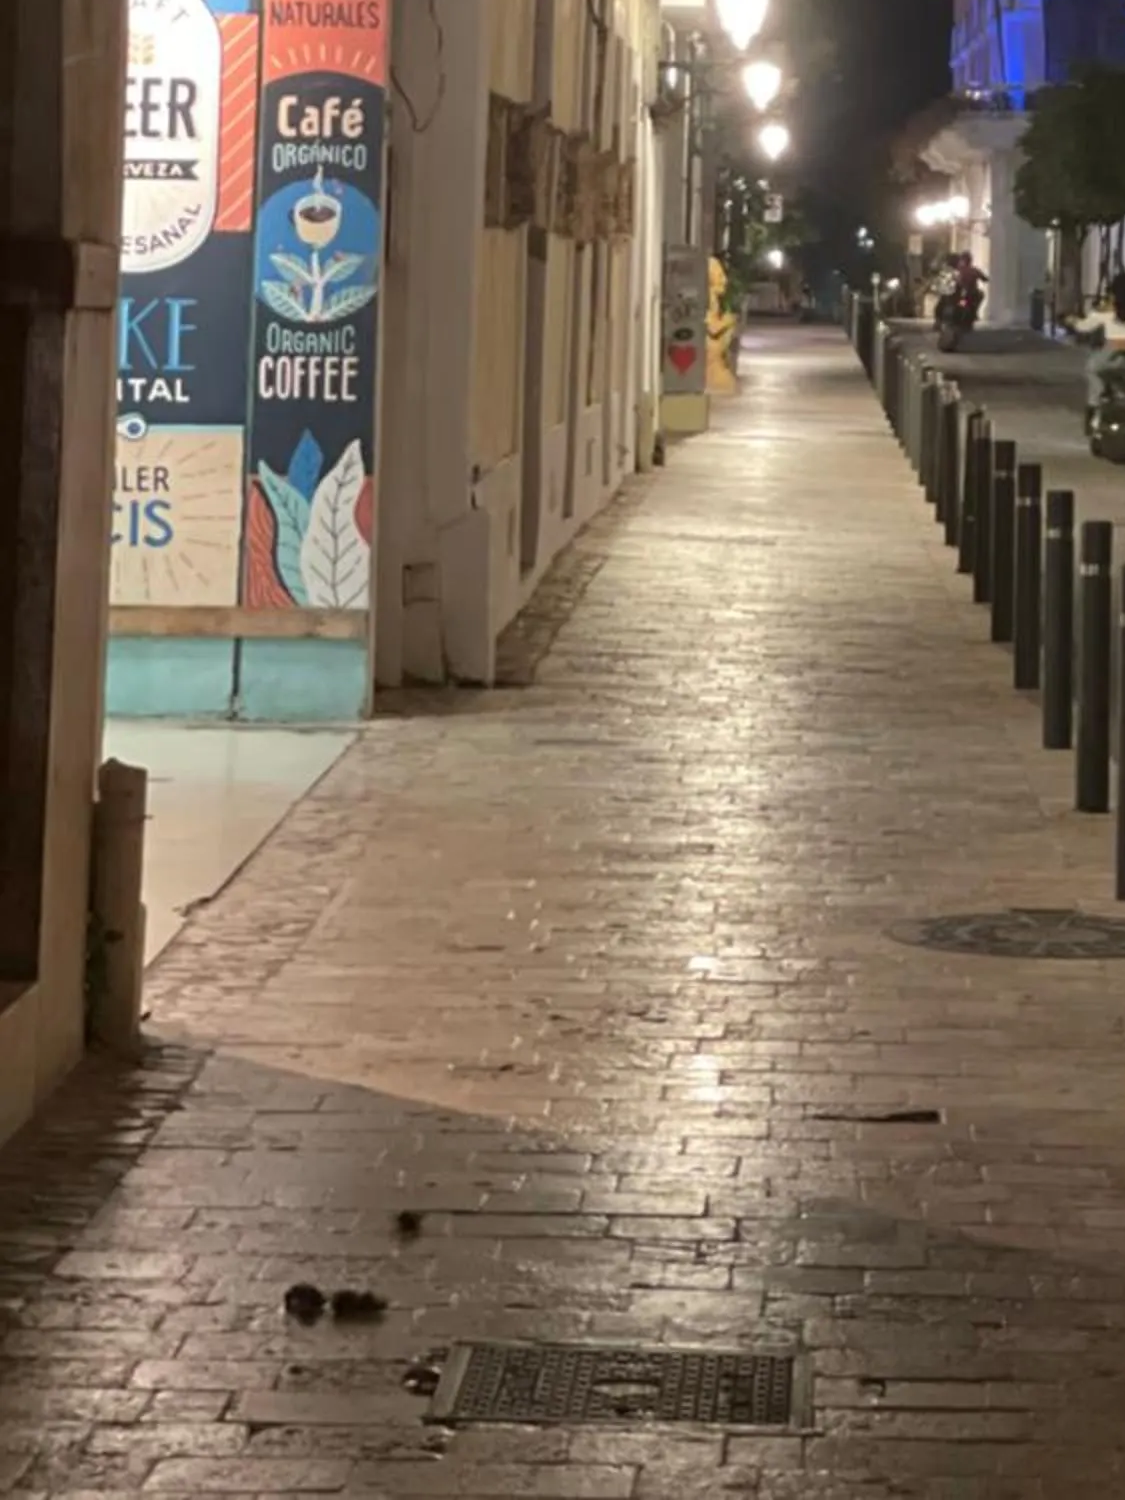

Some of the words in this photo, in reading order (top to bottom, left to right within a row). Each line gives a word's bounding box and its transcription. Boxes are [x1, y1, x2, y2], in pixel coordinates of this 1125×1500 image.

[269, 1, 381, 29] NATURALES
[278, 95, 364, 138] Café
[118, 297, 198, 370] KE
[266, 322, 356, 354] ORGANIC
[116, 378, 190, 402] ITAL
[259, 355, 359, 401] COFFEE
